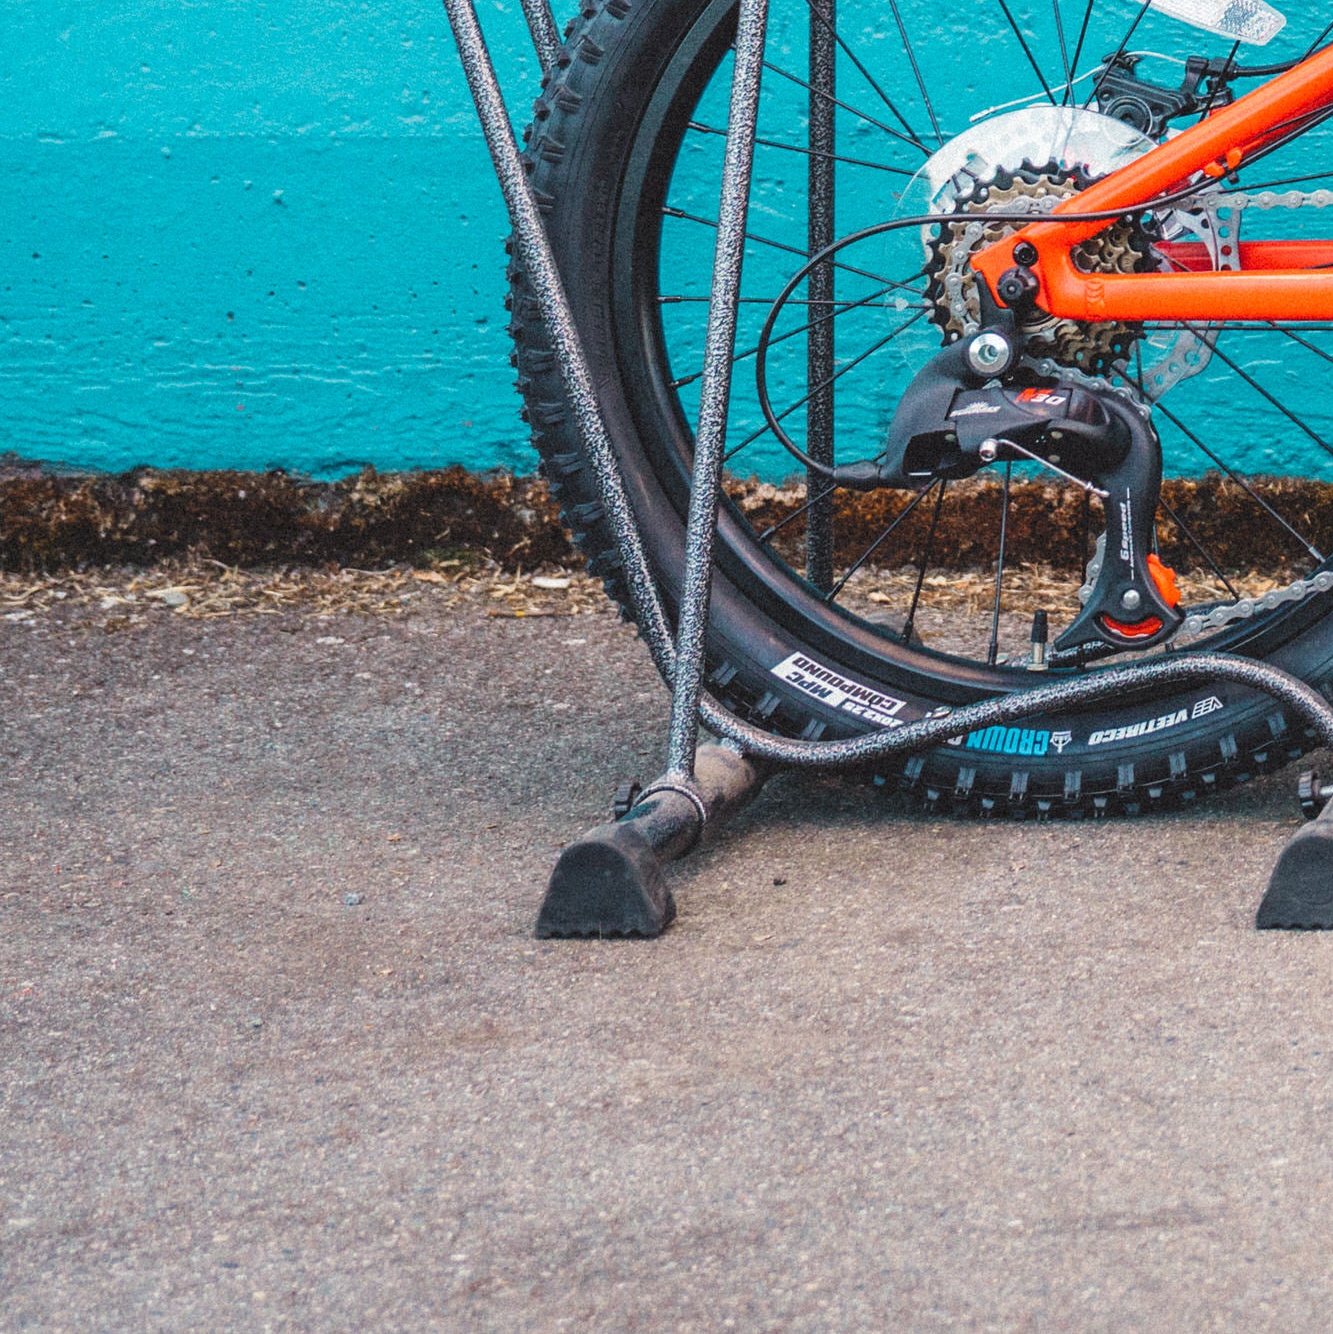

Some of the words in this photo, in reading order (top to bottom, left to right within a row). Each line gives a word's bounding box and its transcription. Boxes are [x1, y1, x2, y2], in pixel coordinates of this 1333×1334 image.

[784, 670, 833, 700] MPC
[791, 656, 898, 711] COMPOUND
[1087, 708, 1189, 746] VEETIRECO
